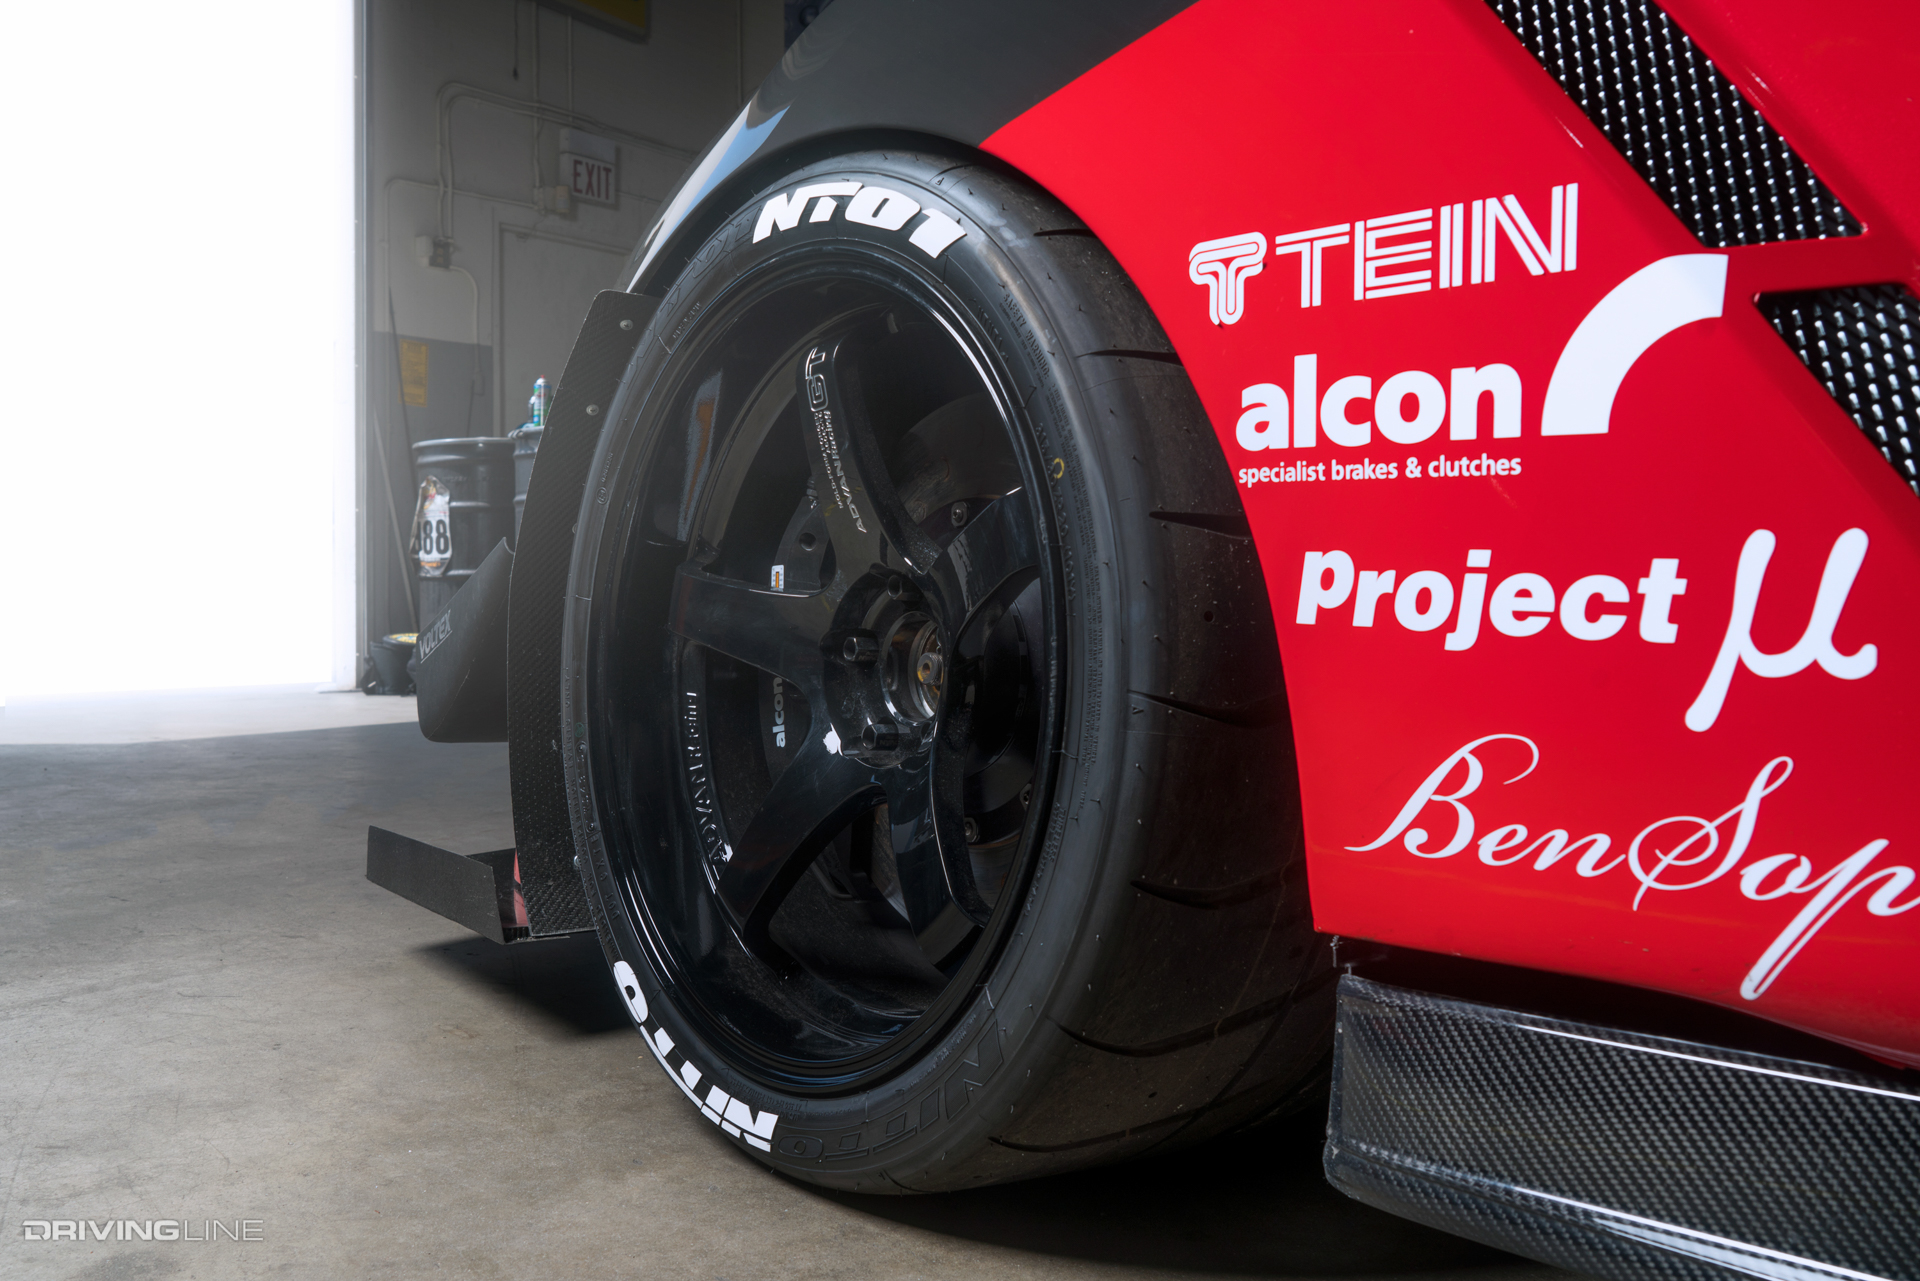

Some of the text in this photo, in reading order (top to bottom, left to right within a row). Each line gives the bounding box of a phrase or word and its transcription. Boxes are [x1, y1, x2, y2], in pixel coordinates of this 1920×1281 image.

[573, 158, 613, 200] EXIT
[752, 181, 968, 259] NT01
[1275, 183, 1580, 309] TEIN
[1235, 353, 1524, 452] alcon
[1238, 453, 1523, 489] specialist brakes & clutches
[418, 609, 452, 660] VOLTEX
[1295, 548, 1688, 652] project
[770, 677, 787, 749] alcon
[613, 960, 779, 1153] NITTO
